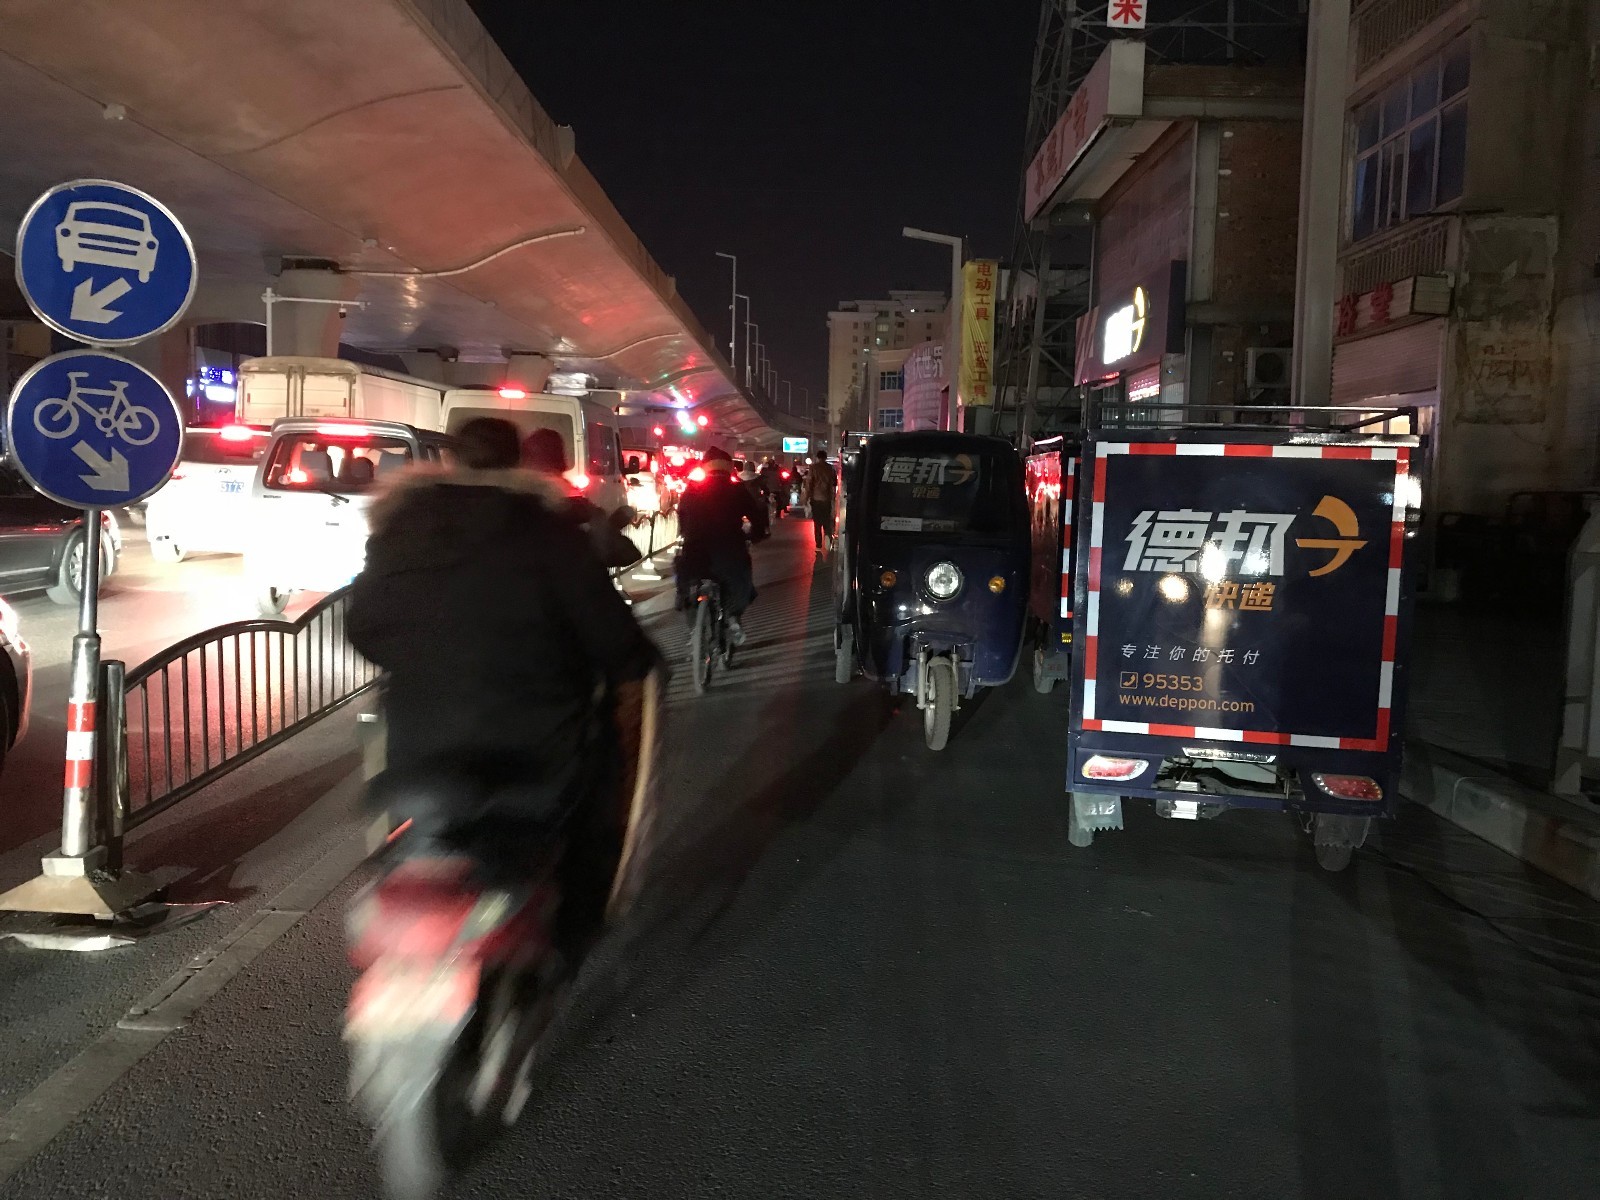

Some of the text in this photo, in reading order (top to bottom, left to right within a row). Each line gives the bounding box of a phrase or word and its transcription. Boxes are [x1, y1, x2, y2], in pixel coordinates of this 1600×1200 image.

[975, 263, 993, 321] 电动工具
[881, 456, 949, 485] 德邦
[1122, 508, 1296, 577] 德邦
[1204, 580, 1276, 612] 快递
[1121, 643, 1260, 666] 专注你的托付
[1143, 673, 1204, 692] 95353
[1119, 694, 1255, 714] www.deppon.com
